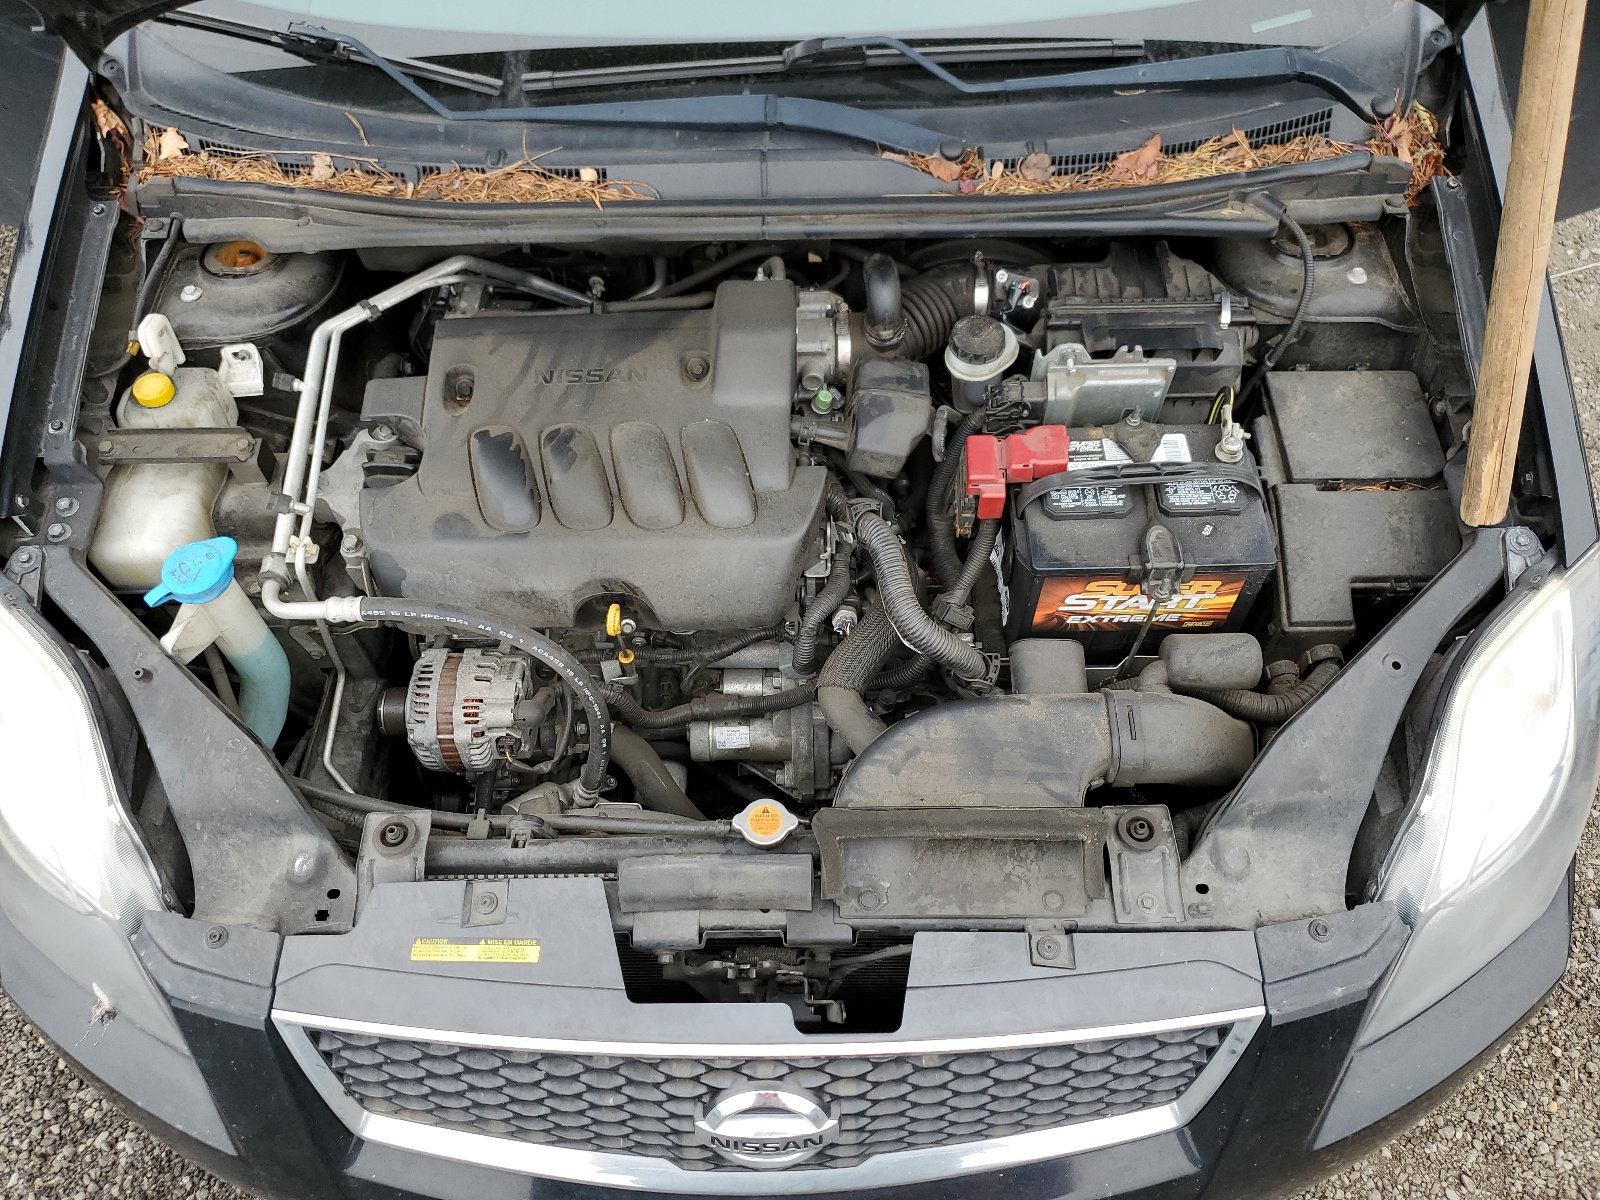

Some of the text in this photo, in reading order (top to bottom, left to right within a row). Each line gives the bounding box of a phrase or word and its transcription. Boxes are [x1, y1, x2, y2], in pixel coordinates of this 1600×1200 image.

[534, 368, 648, 384] NISSAN
[1085, 580, 1222, 596] SUER
[1066, 613, 1183, 624] EXTREME
[477, 624, 492, 632] AA
[710, 1134, 824, 1153] NISSAN
